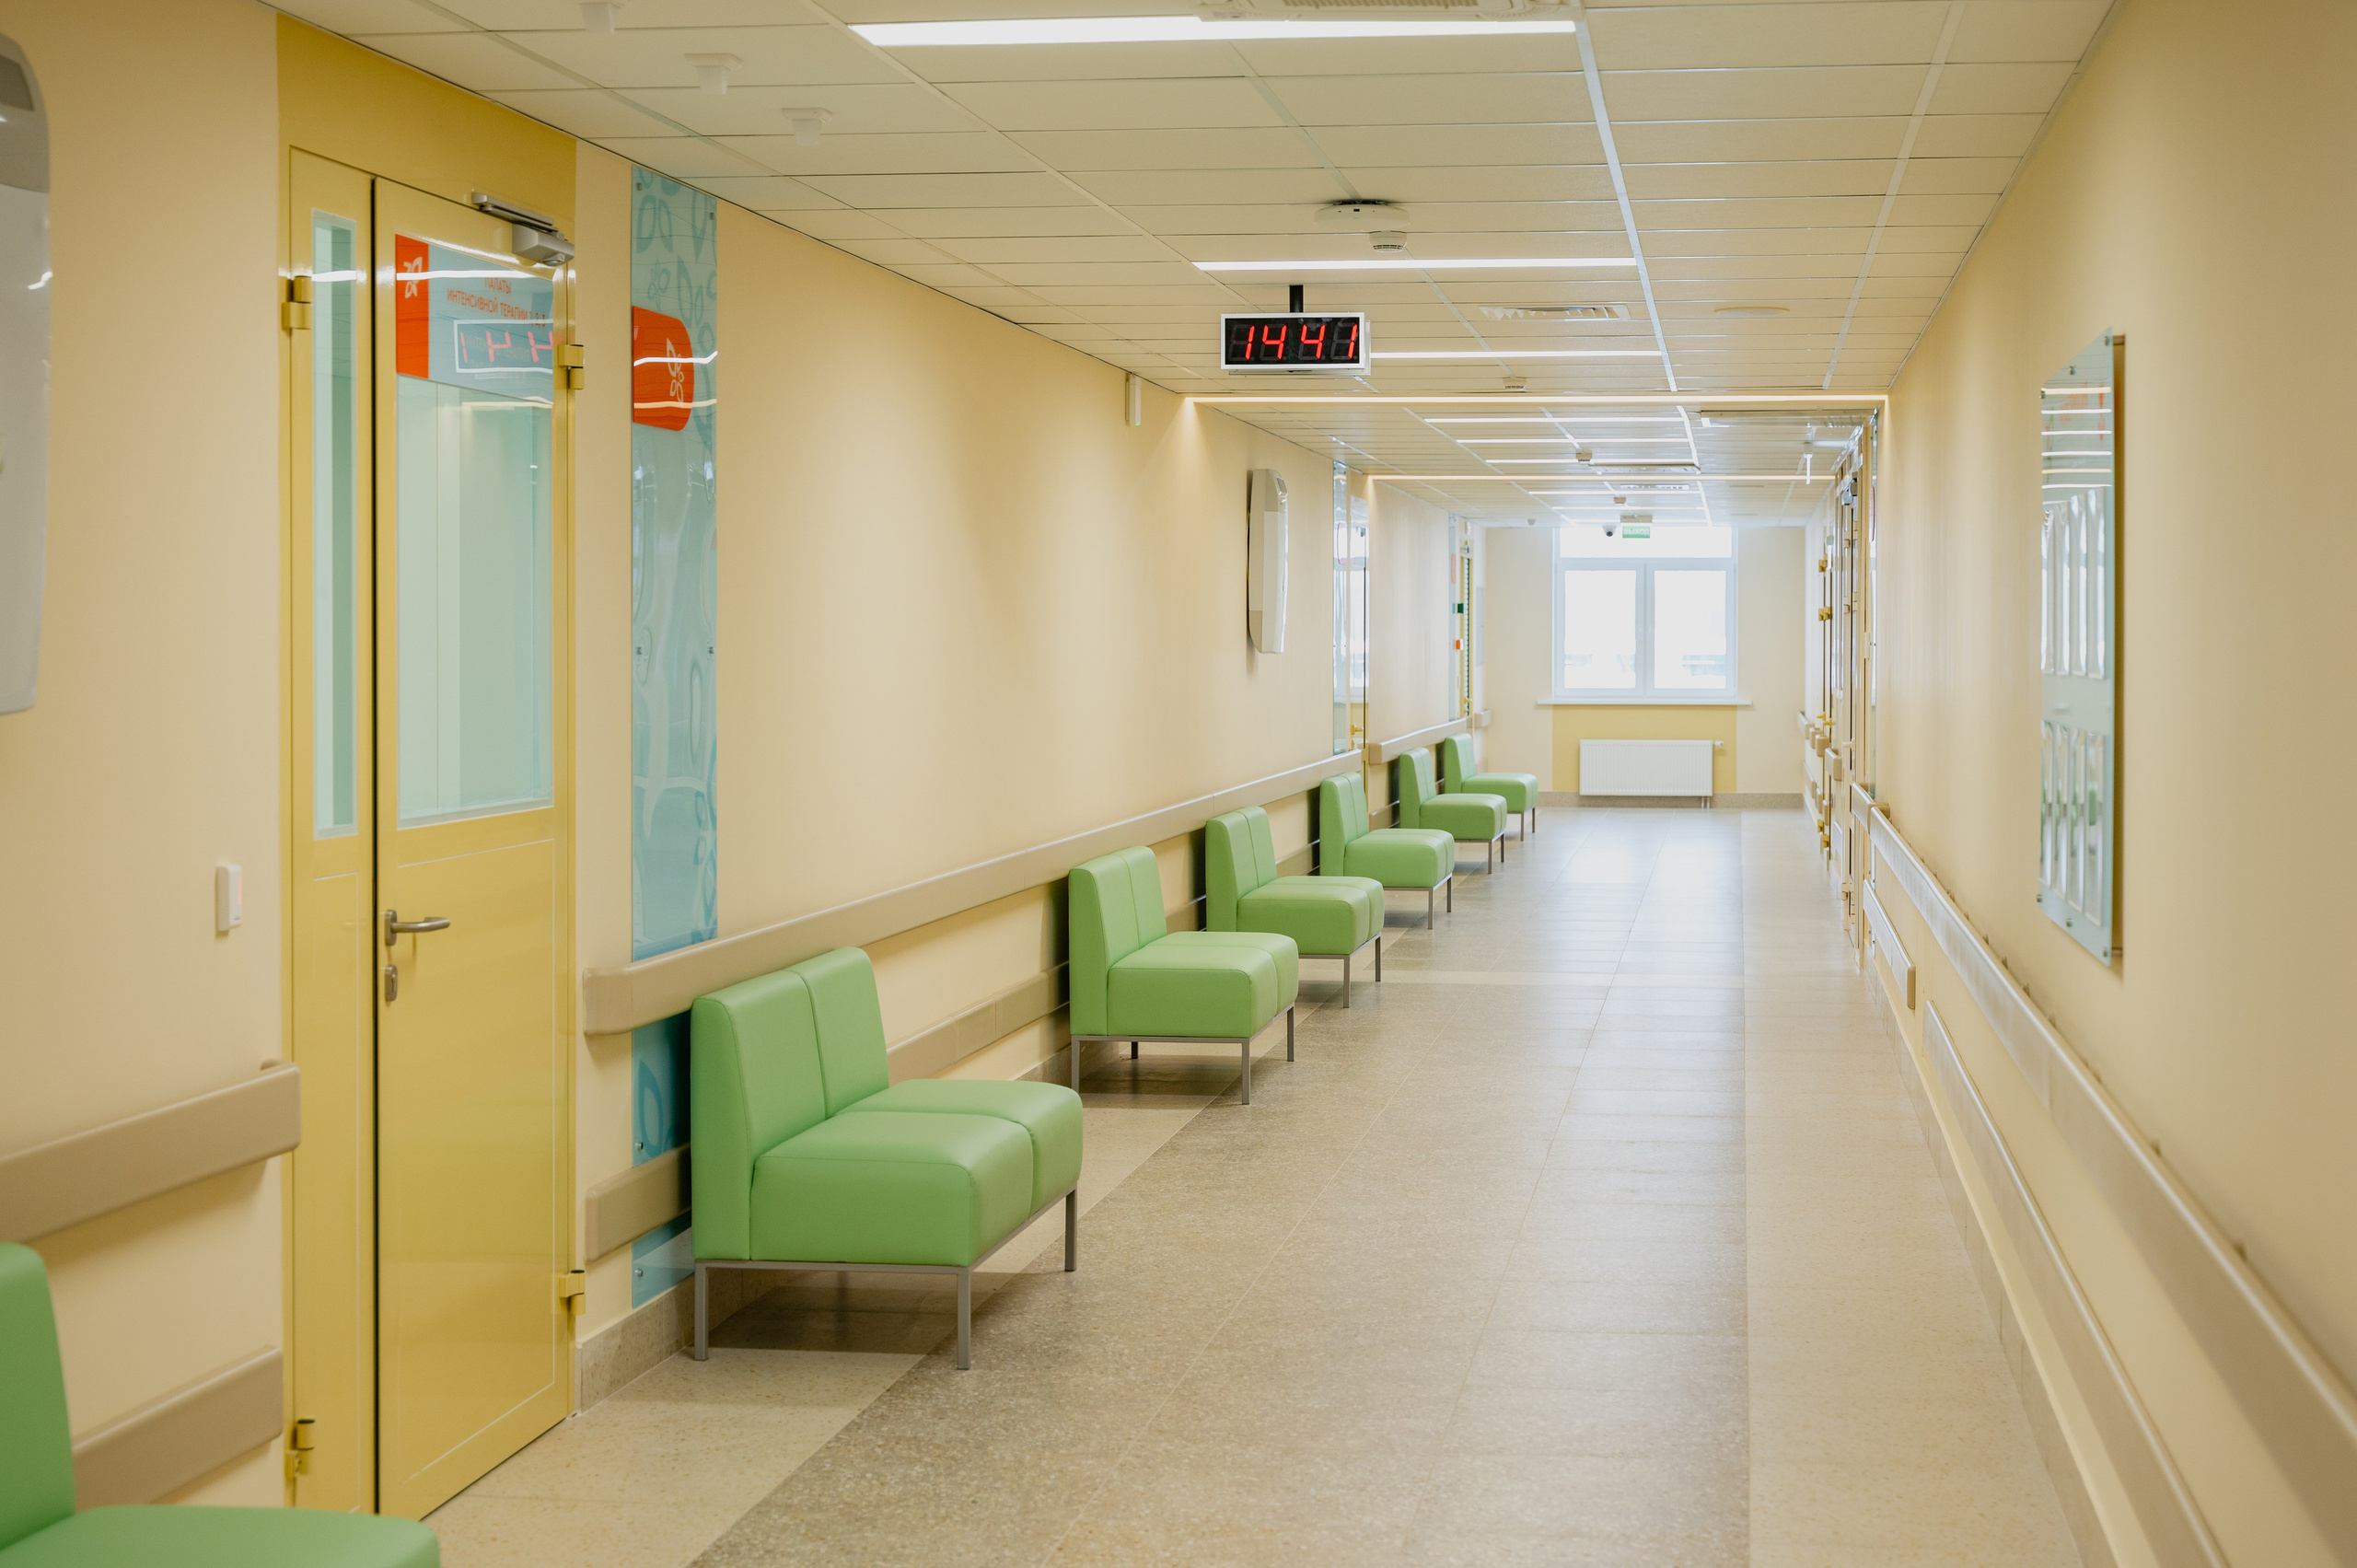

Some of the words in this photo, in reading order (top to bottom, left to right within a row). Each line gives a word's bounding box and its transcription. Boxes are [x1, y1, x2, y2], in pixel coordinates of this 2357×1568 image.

[484, 277, 512, 294] ПАЛАТЫ
[447, 287, 498, 313] ИНТЕНСИВНОЙ
[500, 302, 528, 320] ТЕРАПИИ
[1623, 528, 1649, 536] ВЫХОД
